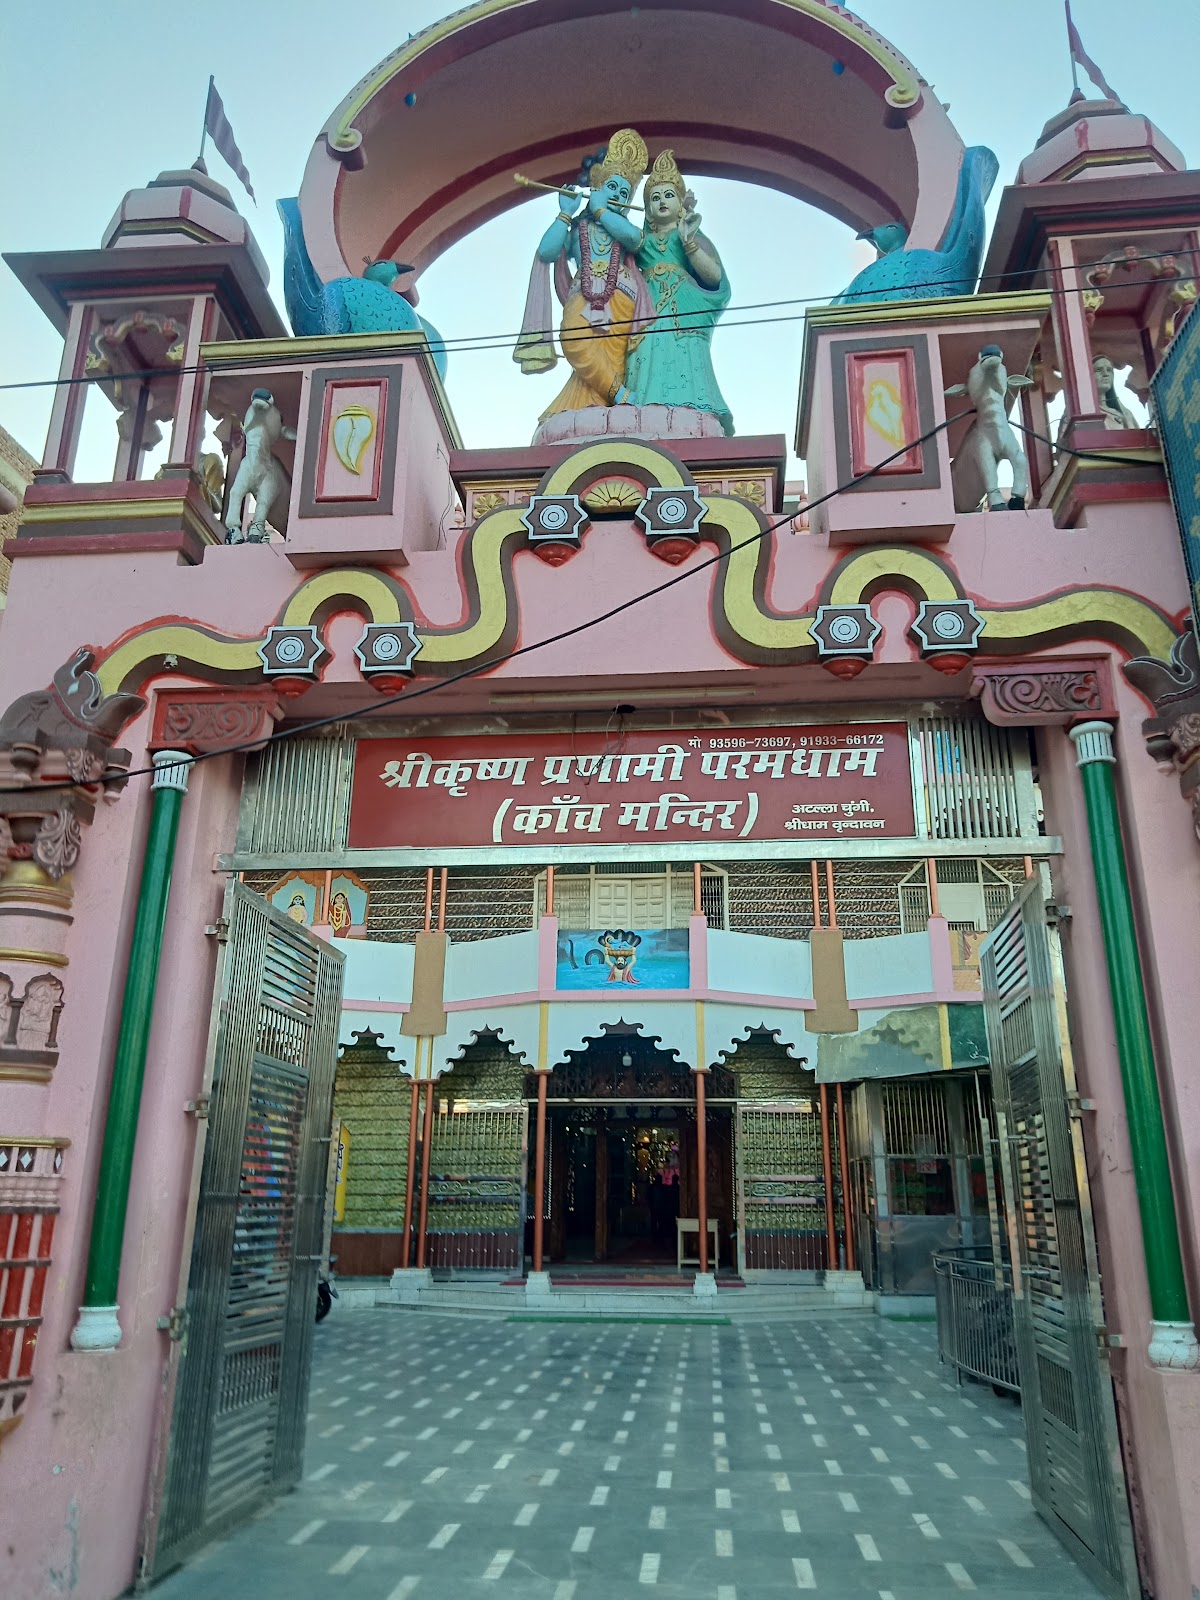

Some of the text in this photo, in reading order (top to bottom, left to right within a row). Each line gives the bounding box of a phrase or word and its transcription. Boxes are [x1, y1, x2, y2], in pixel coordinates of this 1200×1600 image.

[799, 734, 884, 747] 91933-66172
[379, 744, 885, 797] श्रीकृष्ण प्रणामी परमधाम
[617, 792, 759, 837] मन्दिर)
[791, 803, 839, 814] अटल्ला
[784, 817, 886, 833] श्रीधाम वृन्दावन
